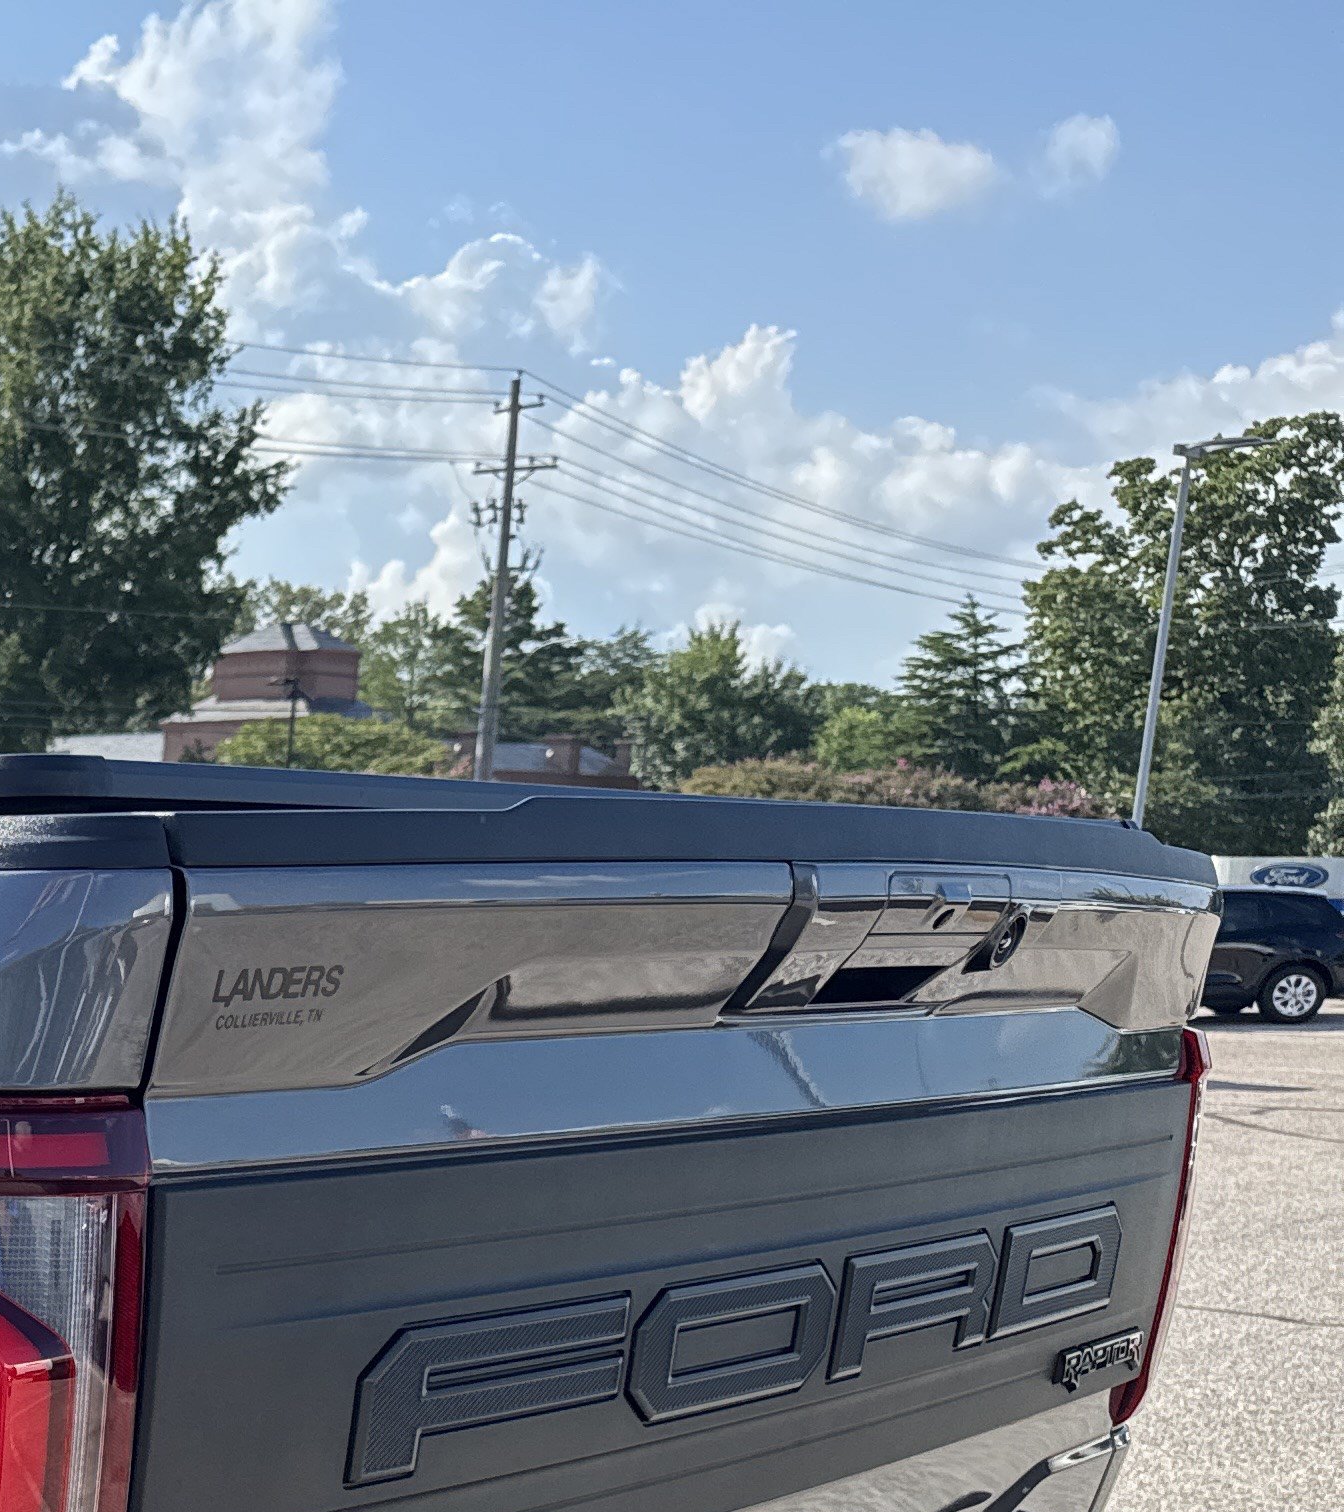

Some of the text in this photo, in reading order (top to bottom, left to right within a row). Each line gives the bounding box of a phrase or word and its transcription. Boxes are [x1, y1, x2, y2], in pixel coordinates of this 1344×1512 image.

[212, 964, 344, 1007] LANDERS
[216, 1008, 325, 1030] COLLIERVILLE, TN
[343, 1202, 1124, 1489] FORD
[1062, 1330, 1144, 1389] RAPTOR
